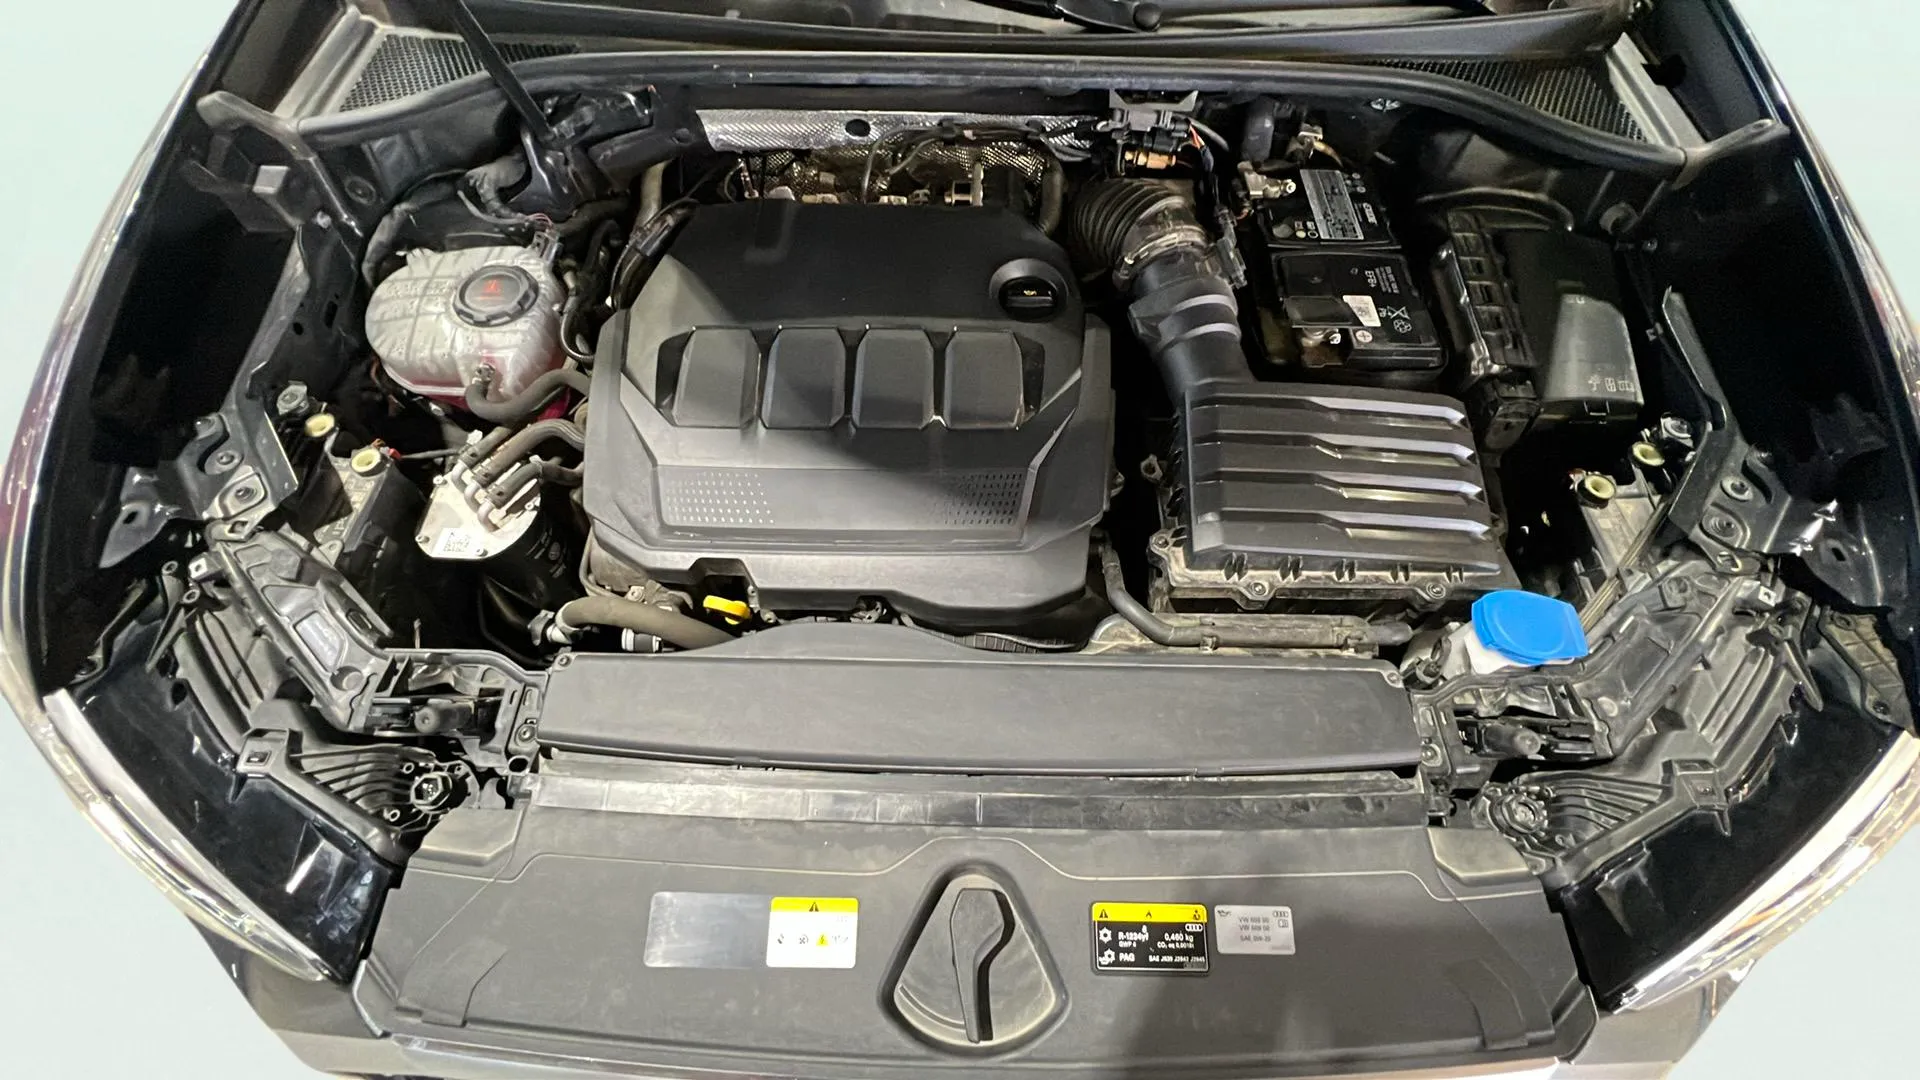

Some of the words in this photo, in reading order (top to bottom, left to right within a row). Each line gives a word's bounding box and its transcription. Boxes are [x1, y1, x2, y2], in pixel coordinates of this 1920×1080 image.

[1118, 931, 1149, 942] R-1234yf
[1185, 933, 1194, 942] kg
[1119, 952, 1135, 962] PAG
